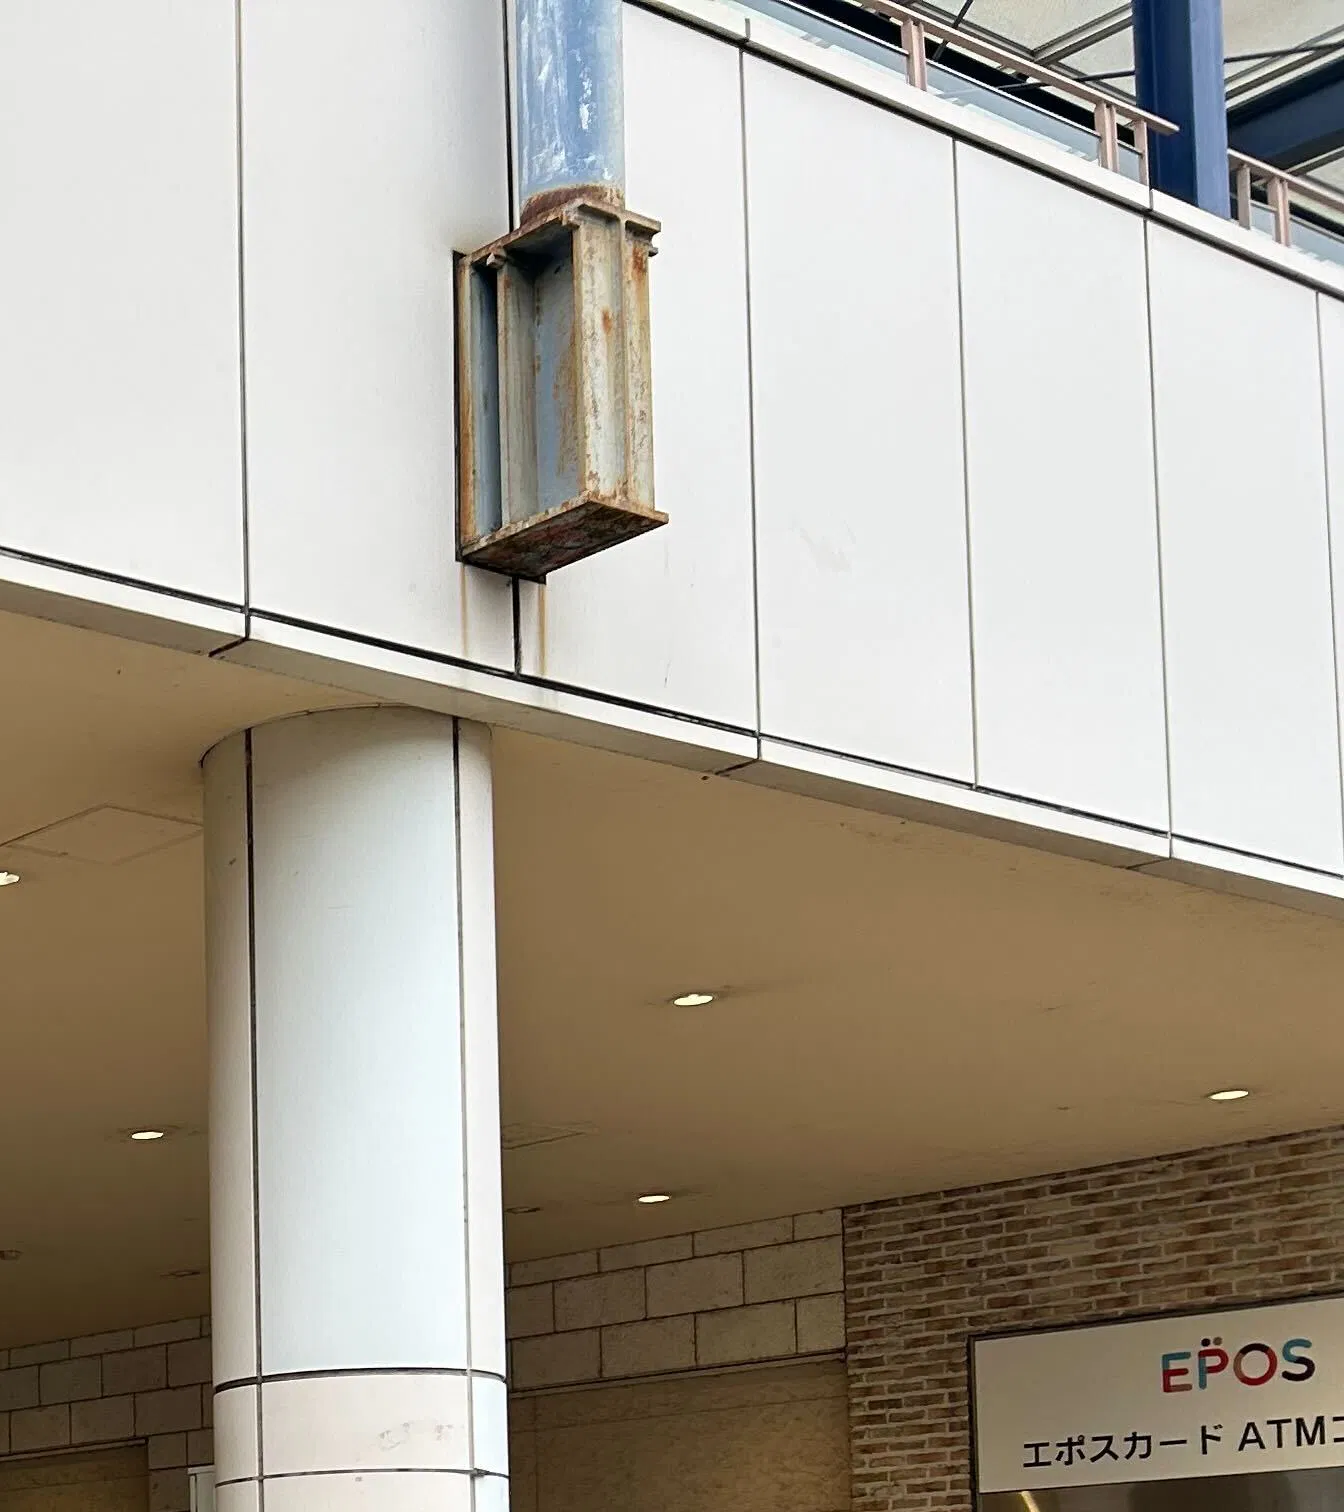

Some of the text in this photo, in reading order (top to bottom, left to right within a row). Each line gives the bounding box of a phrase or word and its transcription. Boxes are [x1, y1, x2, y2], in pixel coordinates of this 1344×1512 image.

[1023, 1425, 1223, 1468] エポスカード
